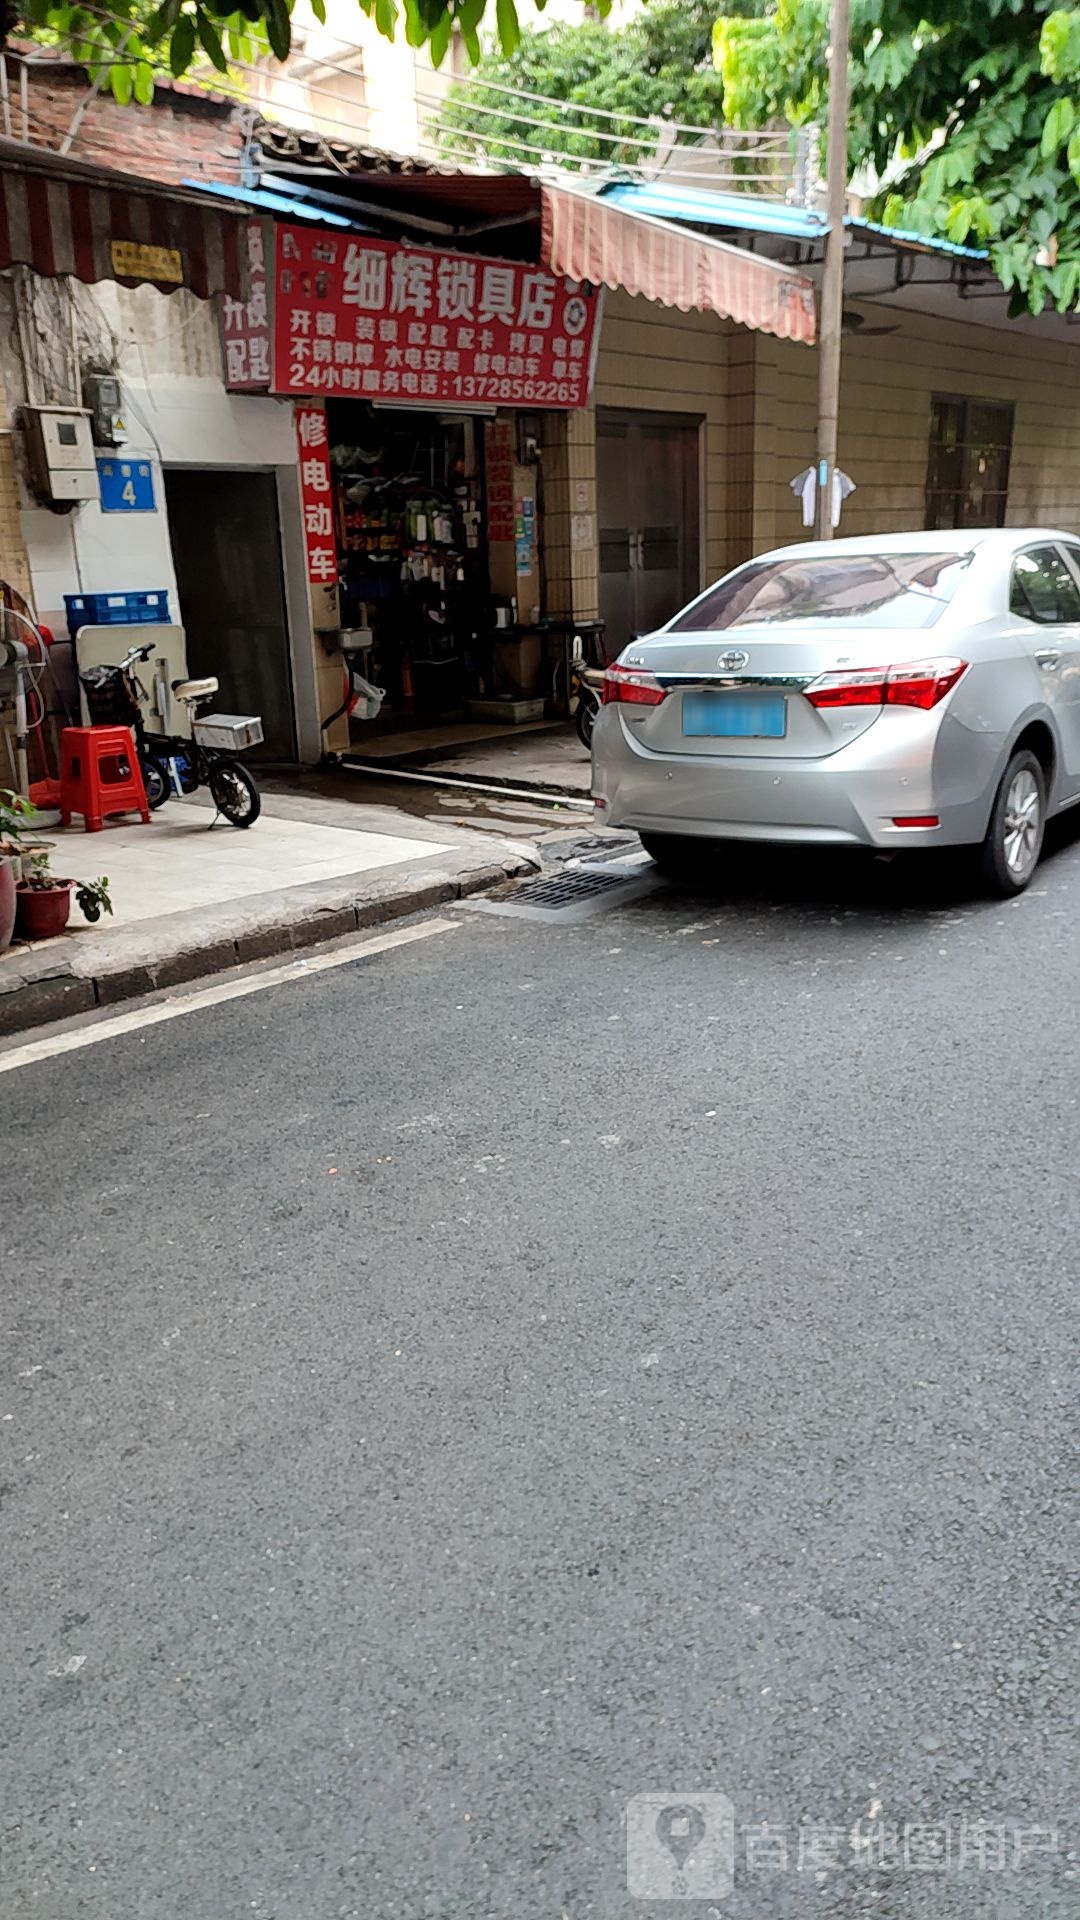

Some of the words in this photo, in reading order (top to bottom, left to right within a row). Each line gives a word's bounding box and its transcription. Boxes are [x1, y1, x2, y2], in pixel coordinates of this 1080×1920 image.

[342, 243, 557, 330] 细辉锁具店
[289, 308, 337, 337] 开锁
[355, 315, 399, 343] 装锁
[456, 326, 495, 351] 配卡
[384, 345, 461, 373] 水电安装
[473, 352, 541, 378] 修电动车
[122, 480, 136, 506] 4
[299, 411, 337, 580] 修电动车
